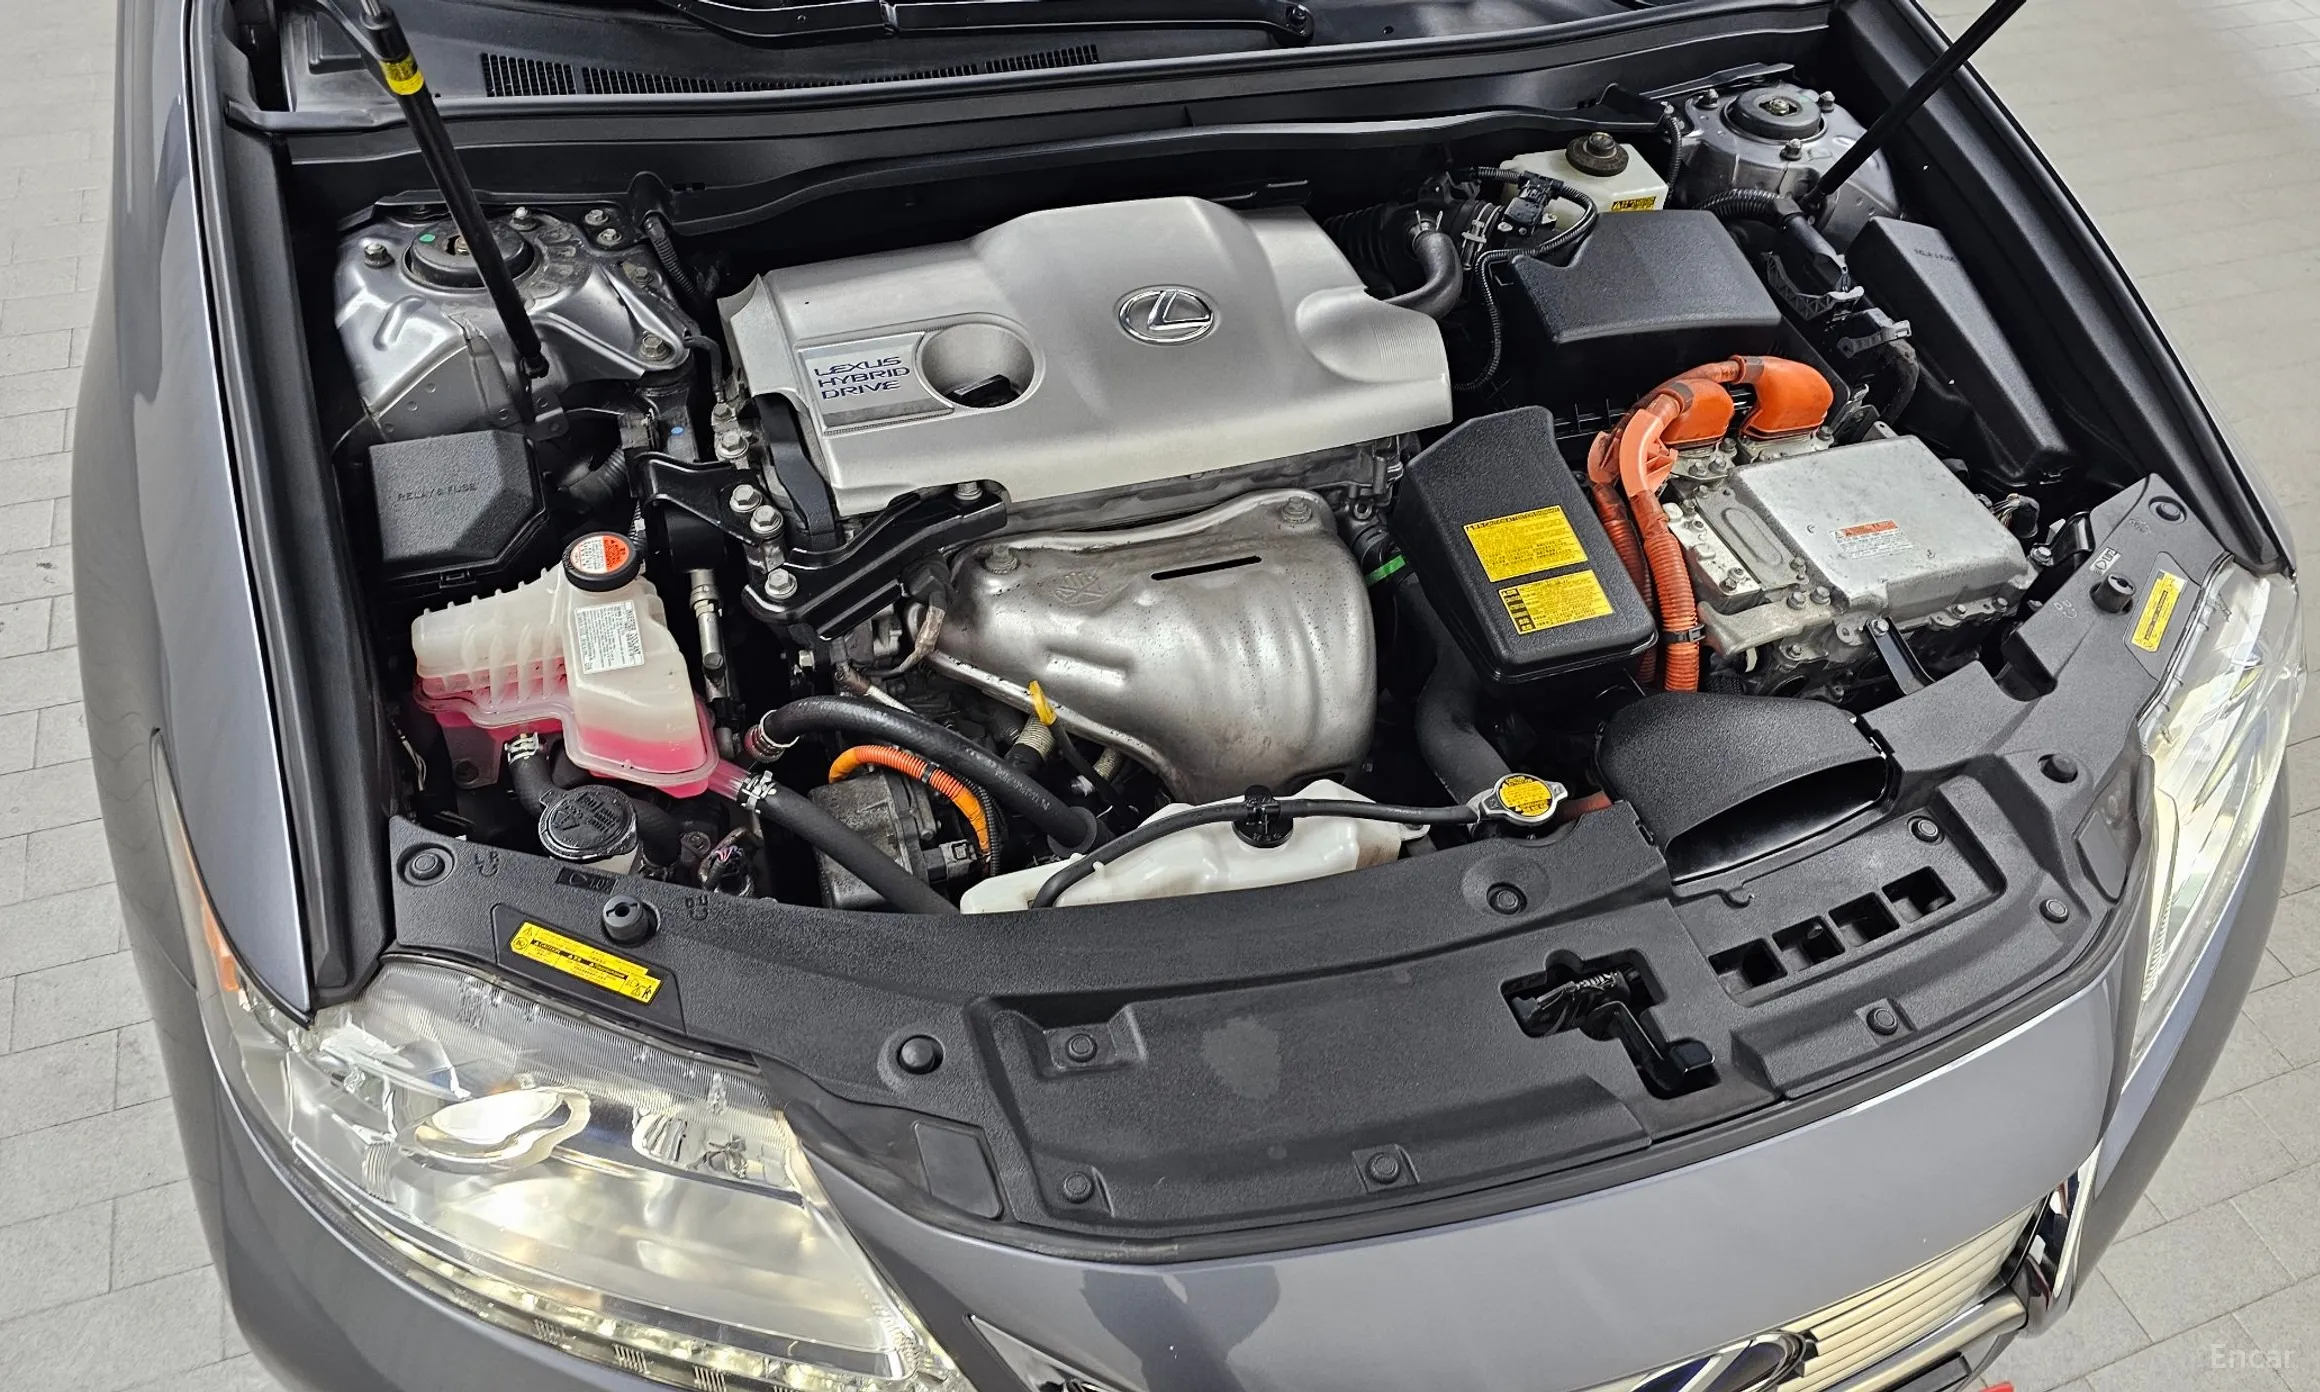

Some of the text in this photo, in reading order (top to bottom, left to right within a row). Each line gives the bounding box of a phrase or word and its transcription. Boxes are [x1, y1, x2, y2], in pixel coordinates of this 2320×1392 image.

[814, 356, 902, 376] LEXUS
[817, 366, 911, 388] HYBRID
[821, 379, 901, 400] DRIVE
